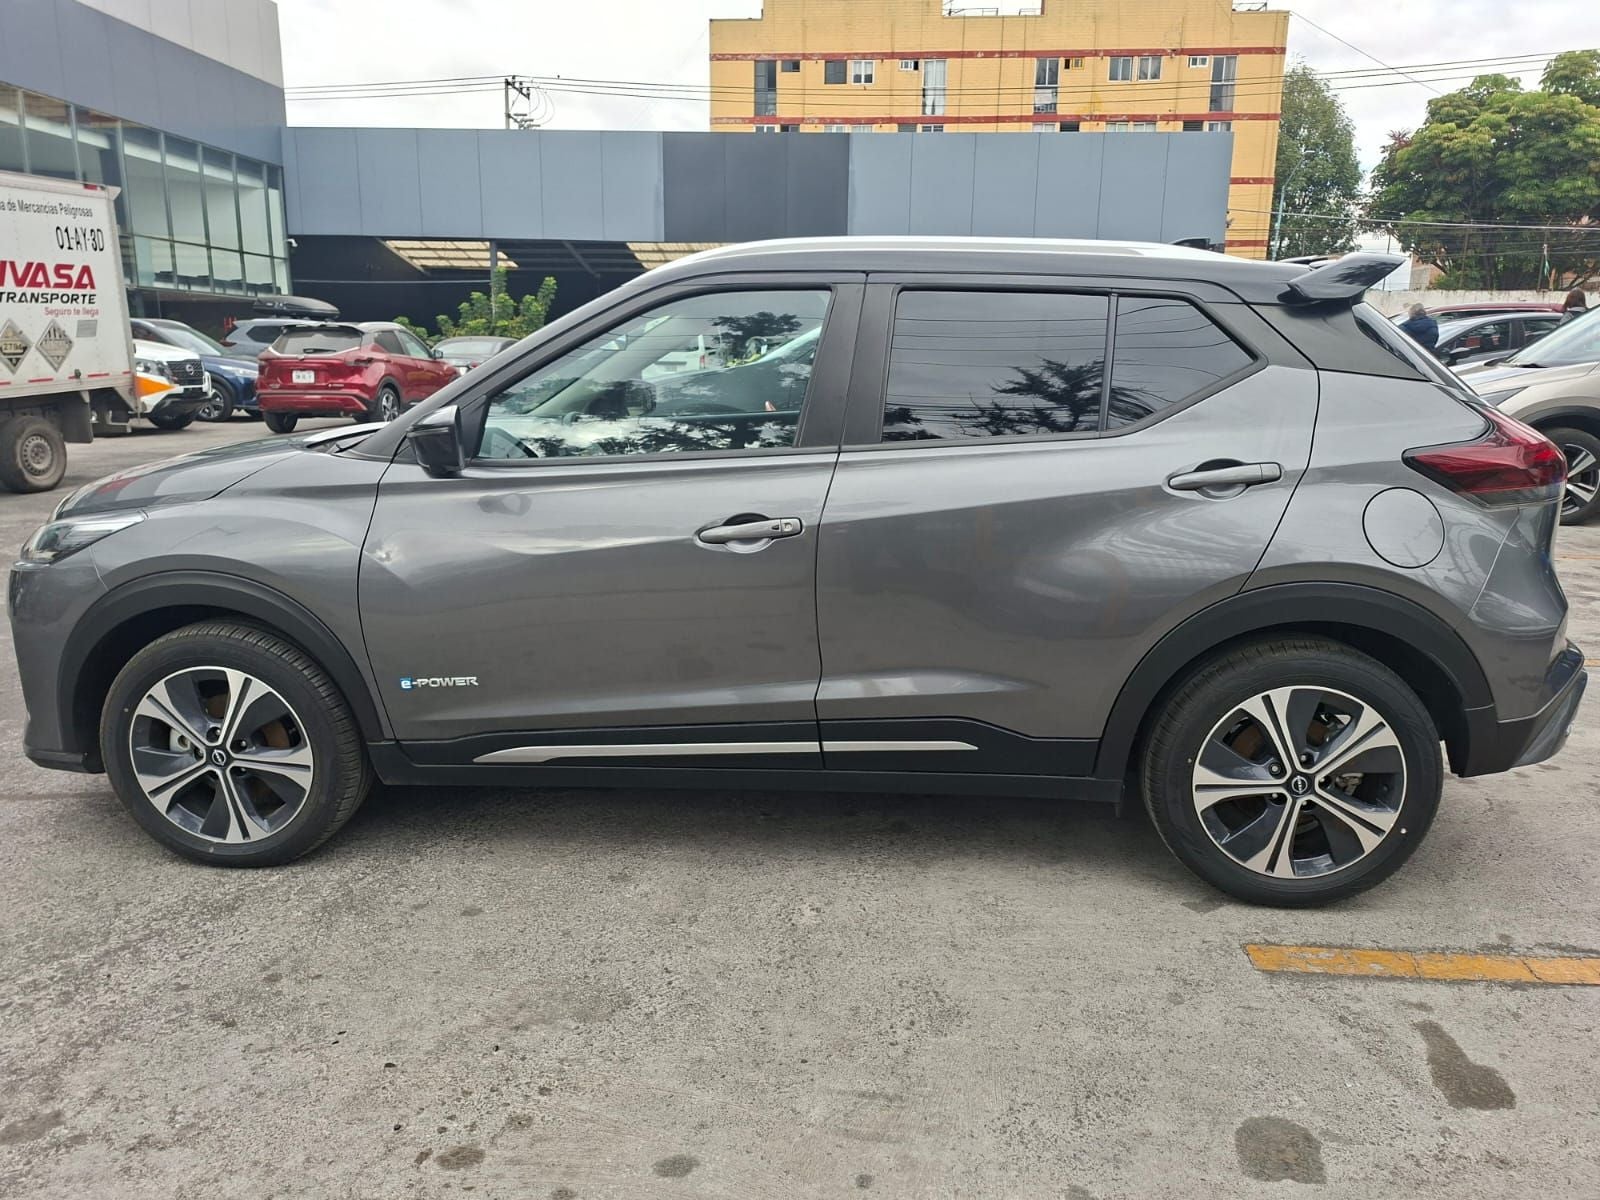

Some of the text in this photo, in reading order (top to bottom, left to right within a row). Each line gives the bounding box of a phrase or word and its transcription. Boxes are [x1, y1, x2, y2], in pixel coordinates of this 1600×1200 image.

[7, 199, 16, 212] de
[59, 202, 93, 219] Peligrosas
[55, 225, 104, 252] 01-AY-3D
[0, 291, 97, 305] TRANSPORTE
[45, 307, 100, 318] Seguro te llega
[400, 676, 479, 689] e-POWER
